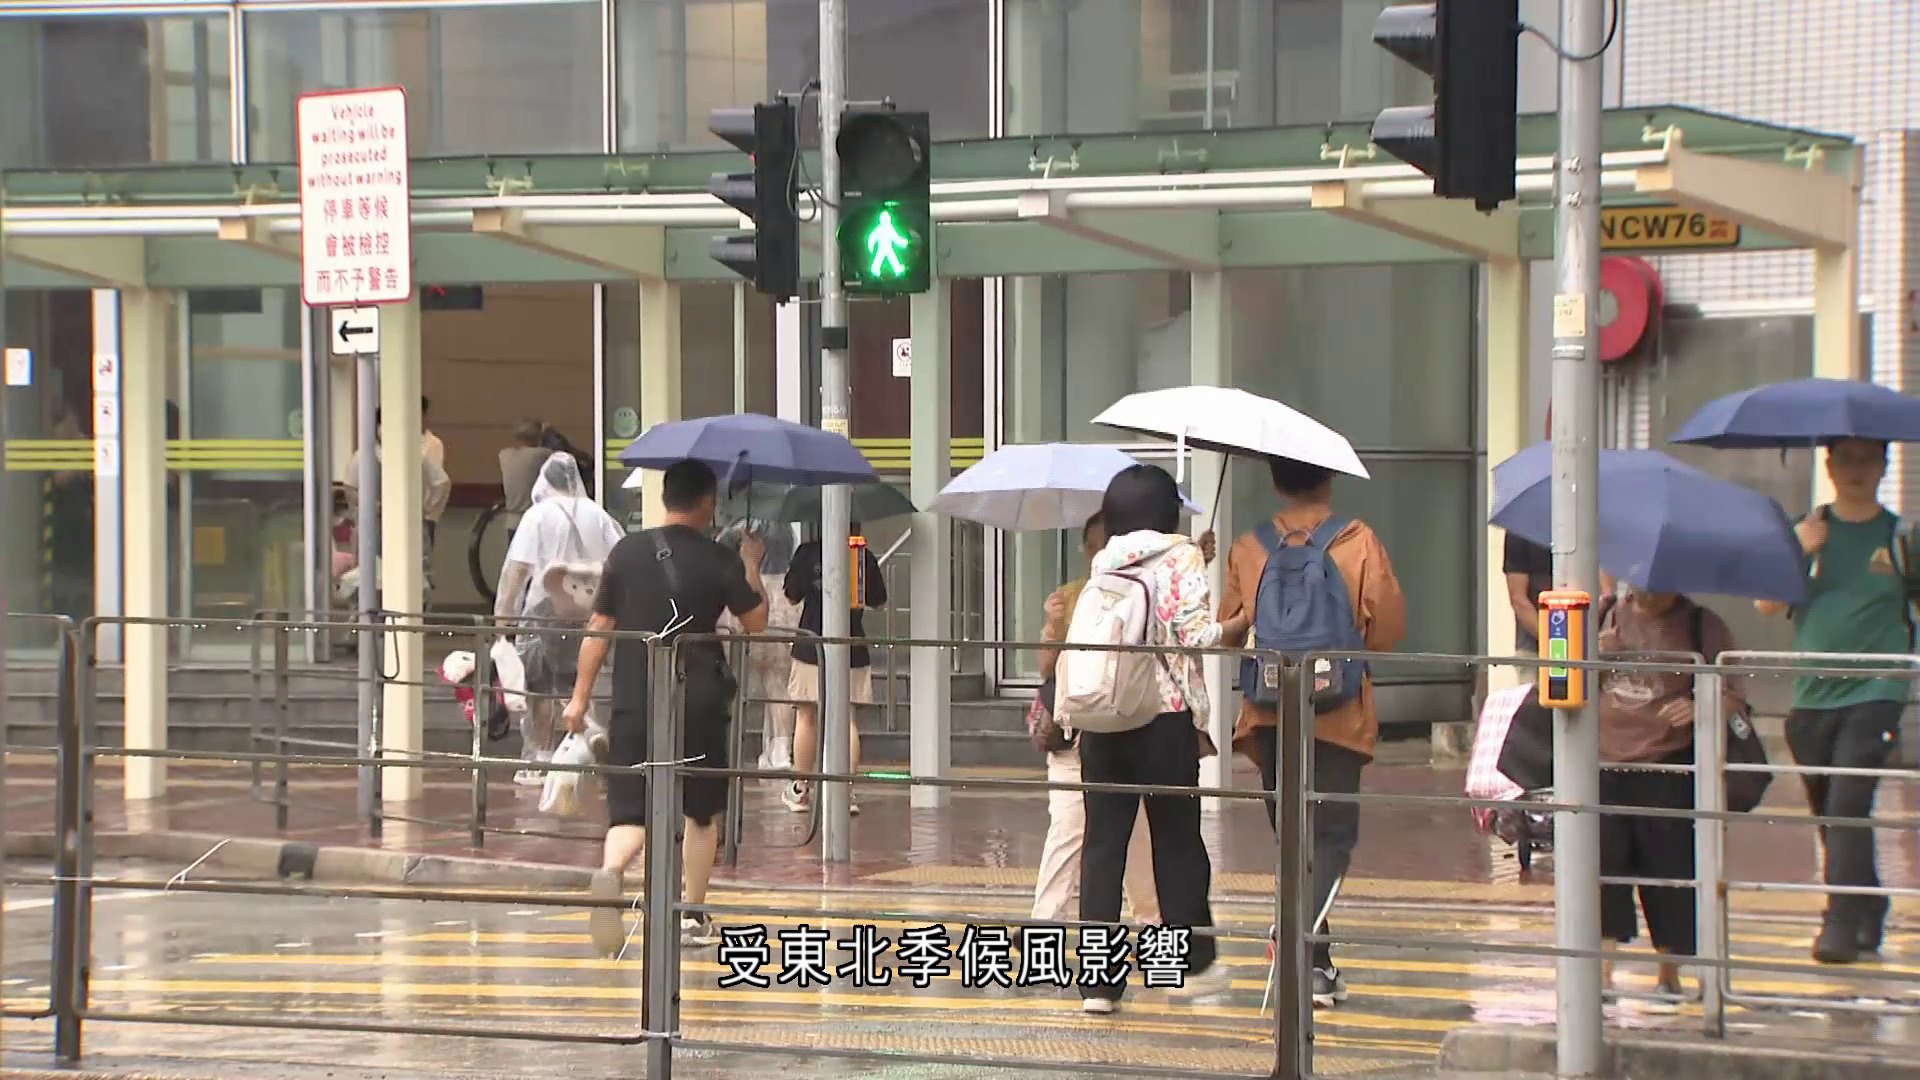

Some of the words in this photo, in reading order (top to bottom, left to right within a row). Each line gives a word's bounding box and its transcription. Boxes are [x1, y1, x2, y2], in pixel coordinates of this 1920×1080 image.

[331, 103, 375, 120] Vehicle
[311, 127, 355, 144] waiting
[358, 123, 379, 140] will
[381, 123, 395, 140] be
[321, 145, 387, 168] prosecuted
[307, 171, 353, 188] without
[356, 168, 402, 186] warning
[323, 195, 389, 223] 停車等候
[315, 266, 399, 293] 而不予警告
